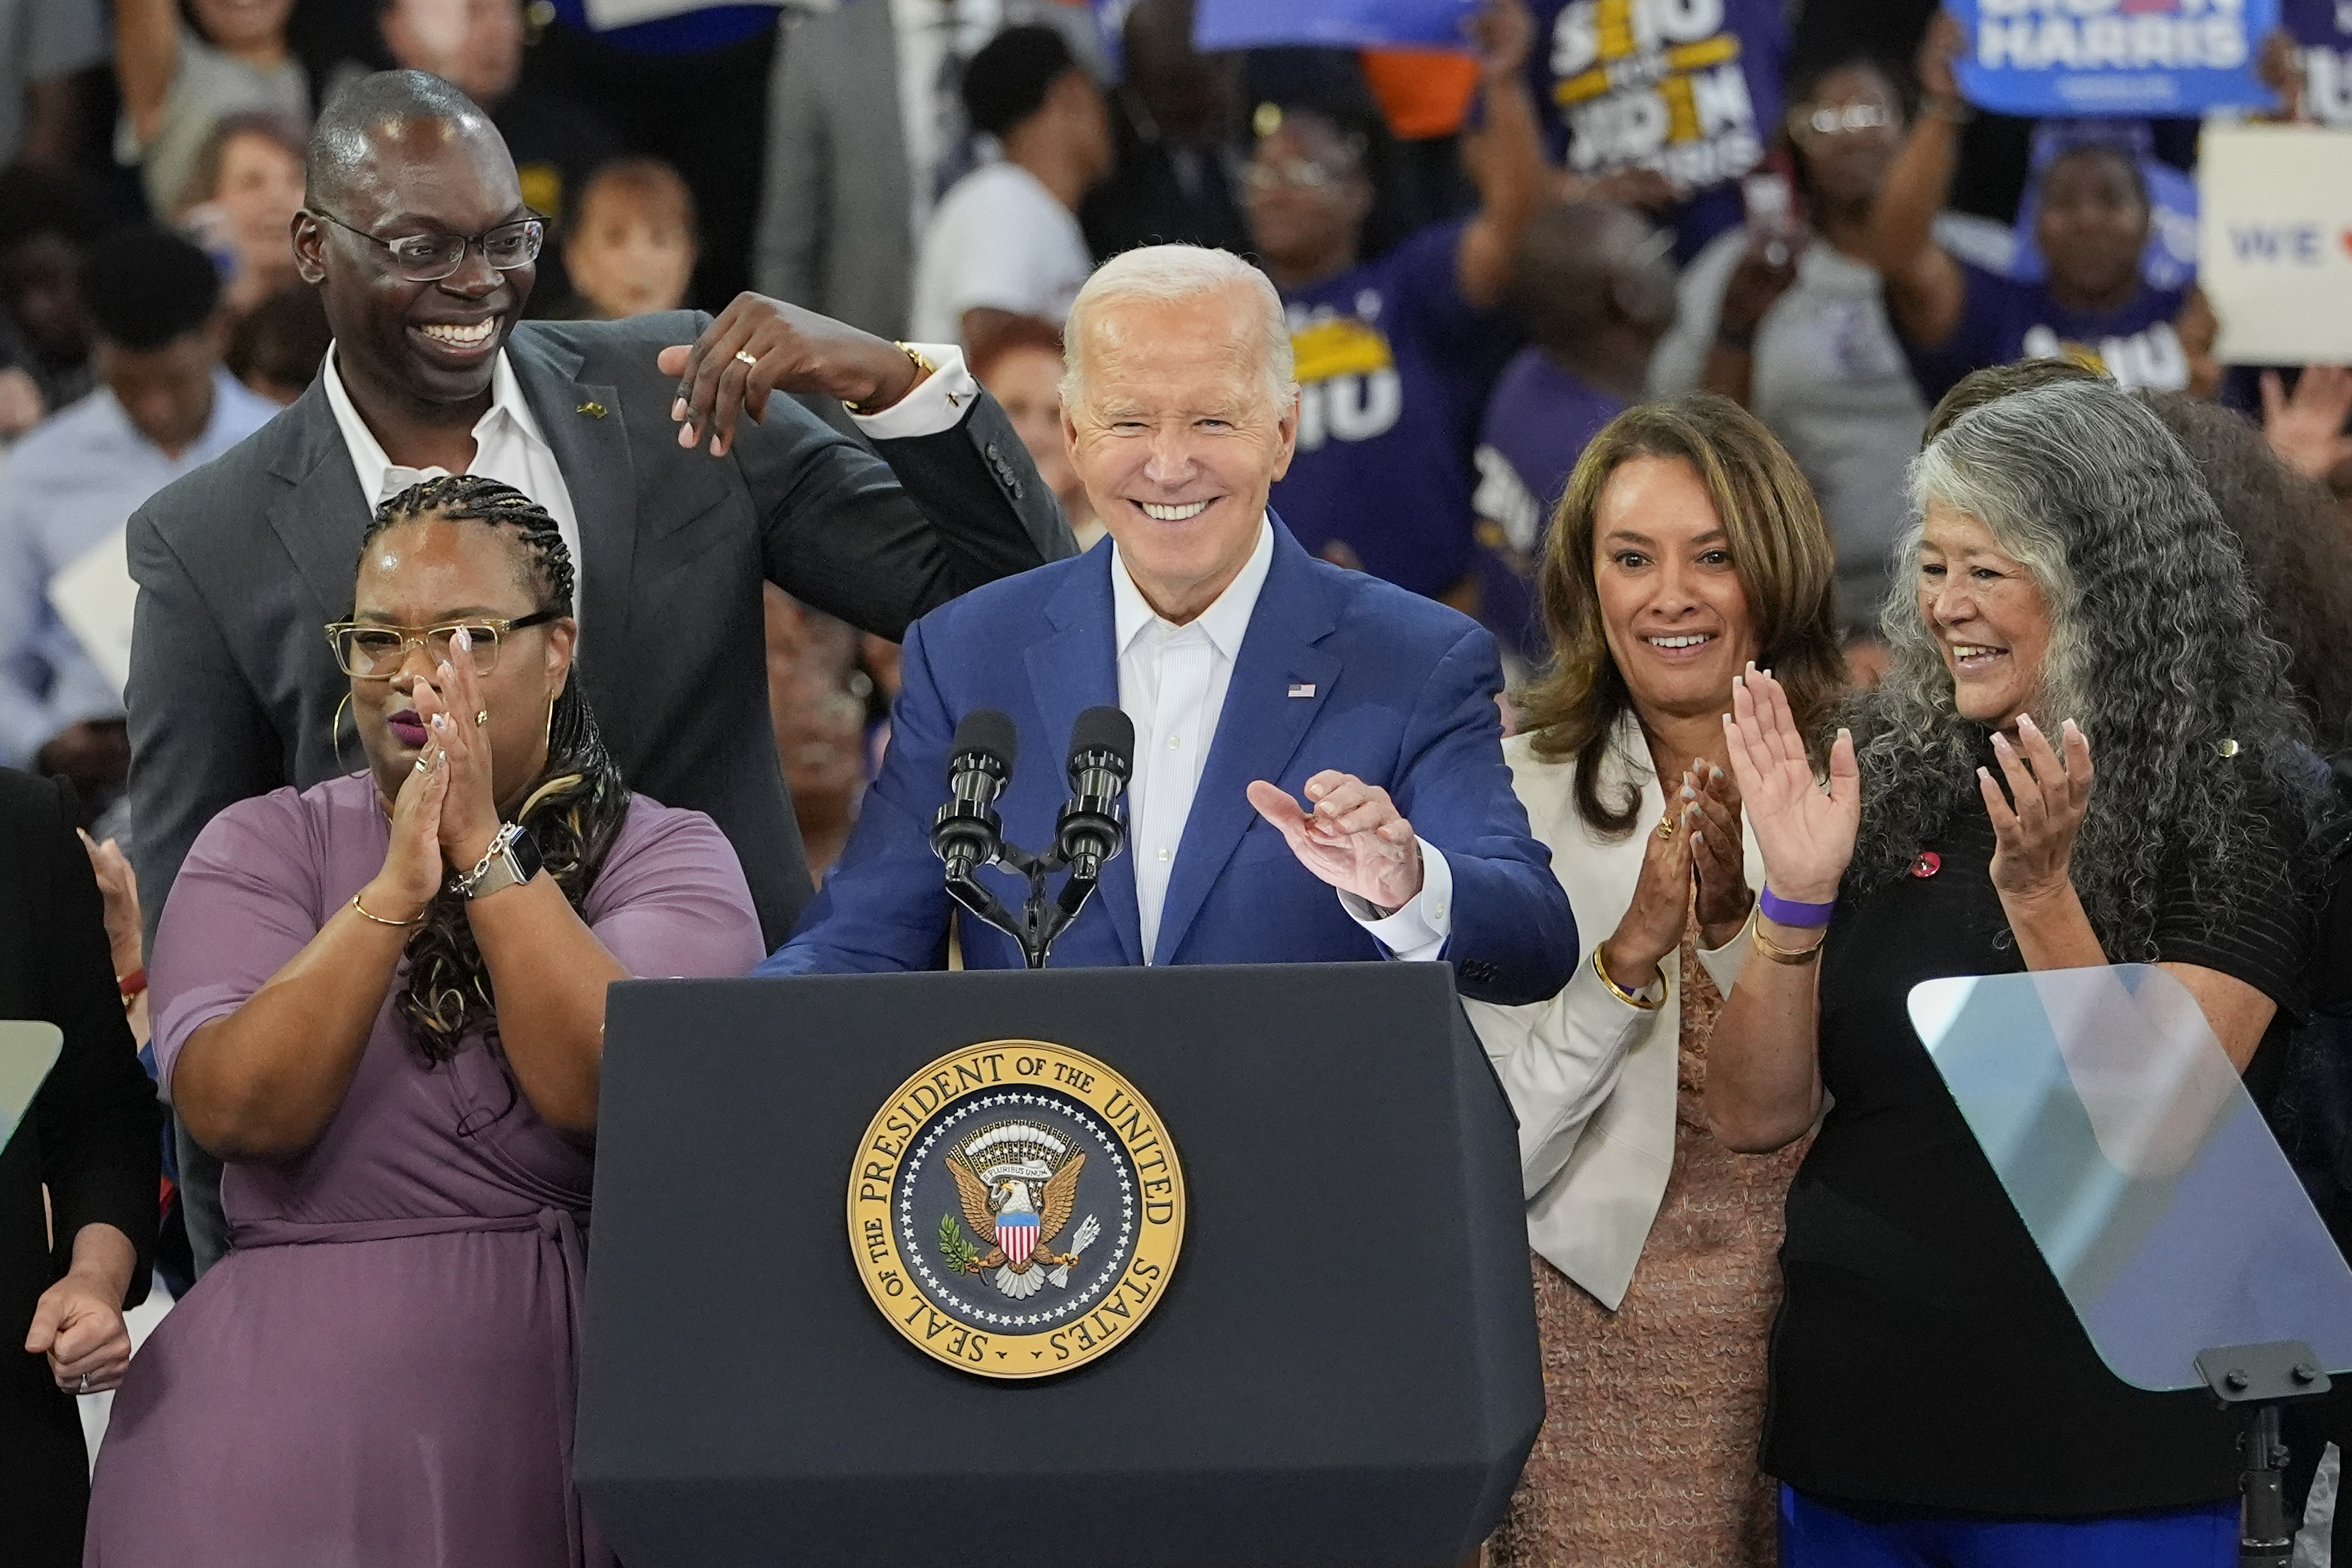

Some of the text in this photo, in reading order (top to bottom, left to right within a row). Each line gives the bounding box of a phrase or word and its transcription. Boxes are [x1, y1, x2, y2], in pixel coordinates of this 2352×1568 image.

[1976, 15, 2249, 70] HARRIS
[2230, 221, 2323, 265] WE
[988, 1166, 1024, 1176] PLURIBUS
[860, 1054, 1173, 1361] SEAL OF THE PRESIDENT OF THE UNITED STATES
